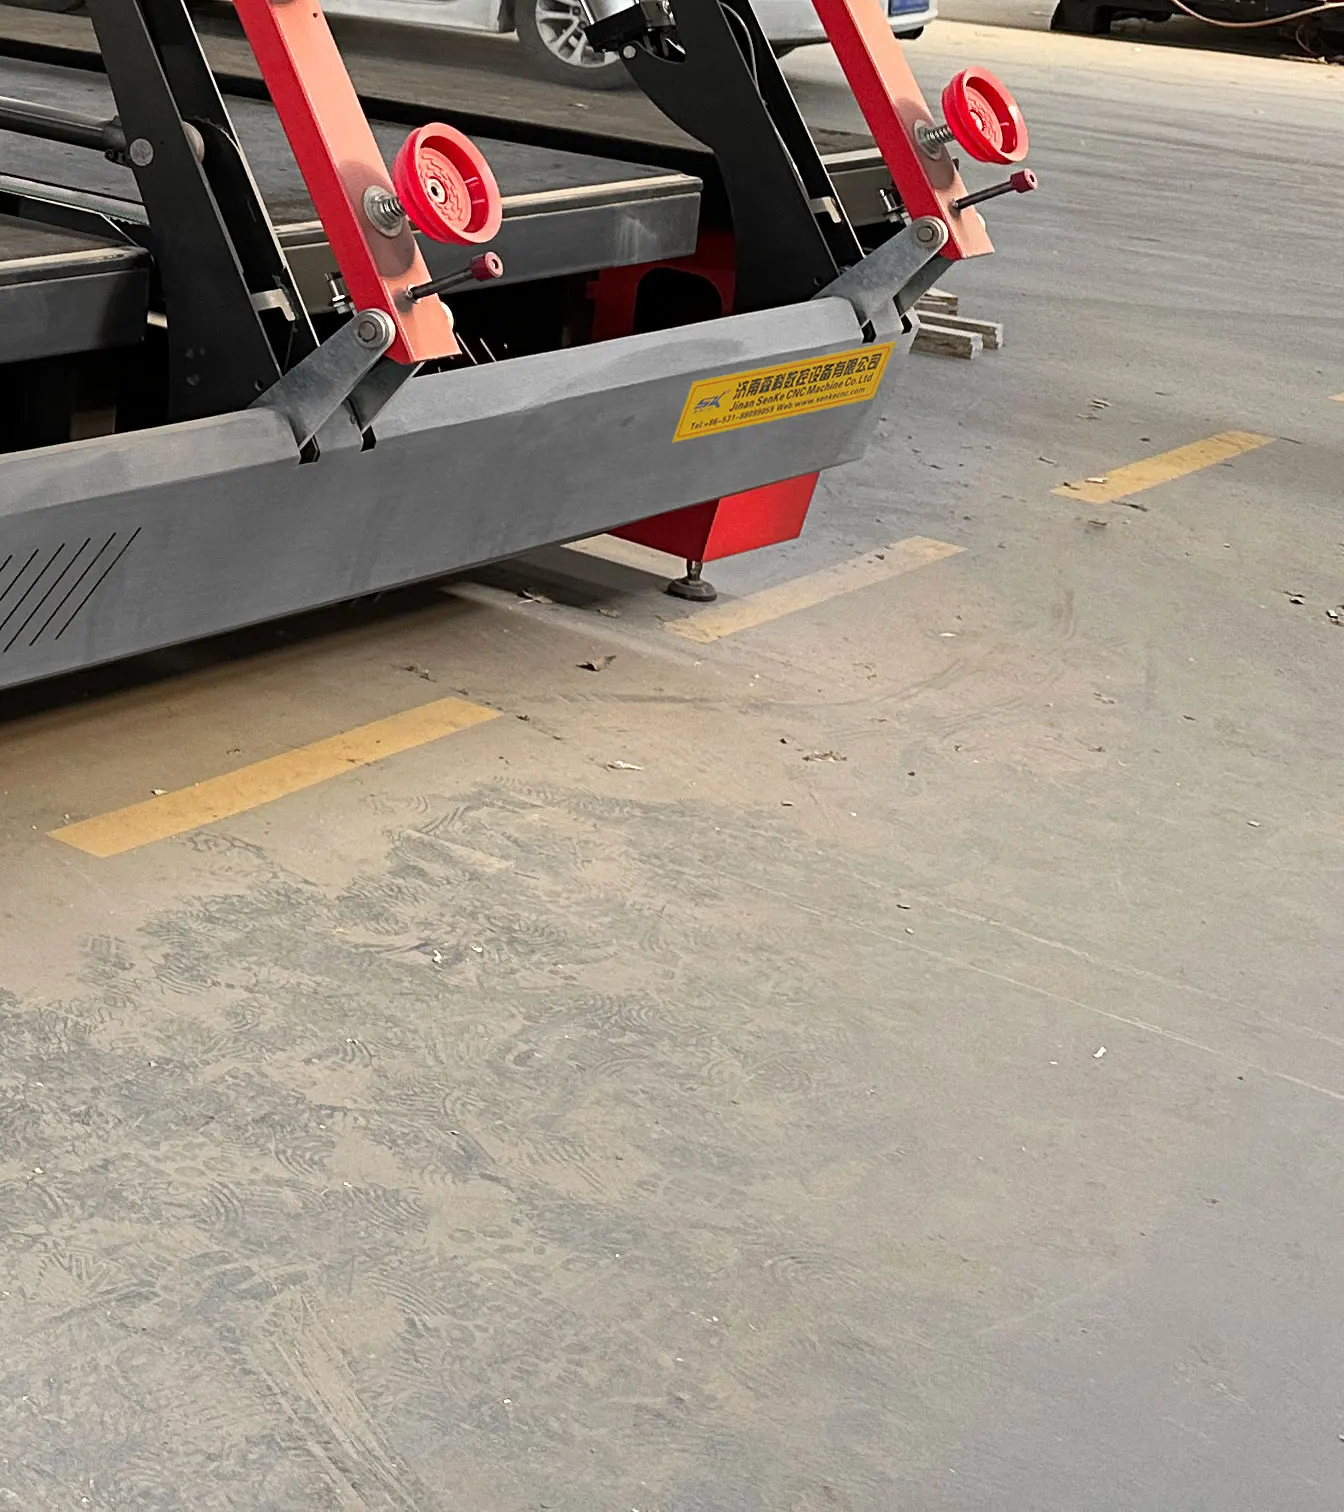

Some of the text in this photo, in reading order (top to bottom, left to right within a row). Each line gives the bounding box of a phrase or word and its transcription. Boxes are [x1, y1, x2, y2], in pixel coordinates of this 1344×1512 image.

[730, 397, 756, 411] Jinan
[756, 392, 786, 406] SenKe
[787, 386, 806, 399] CNC
[806, 379, 844, 396] Machine
